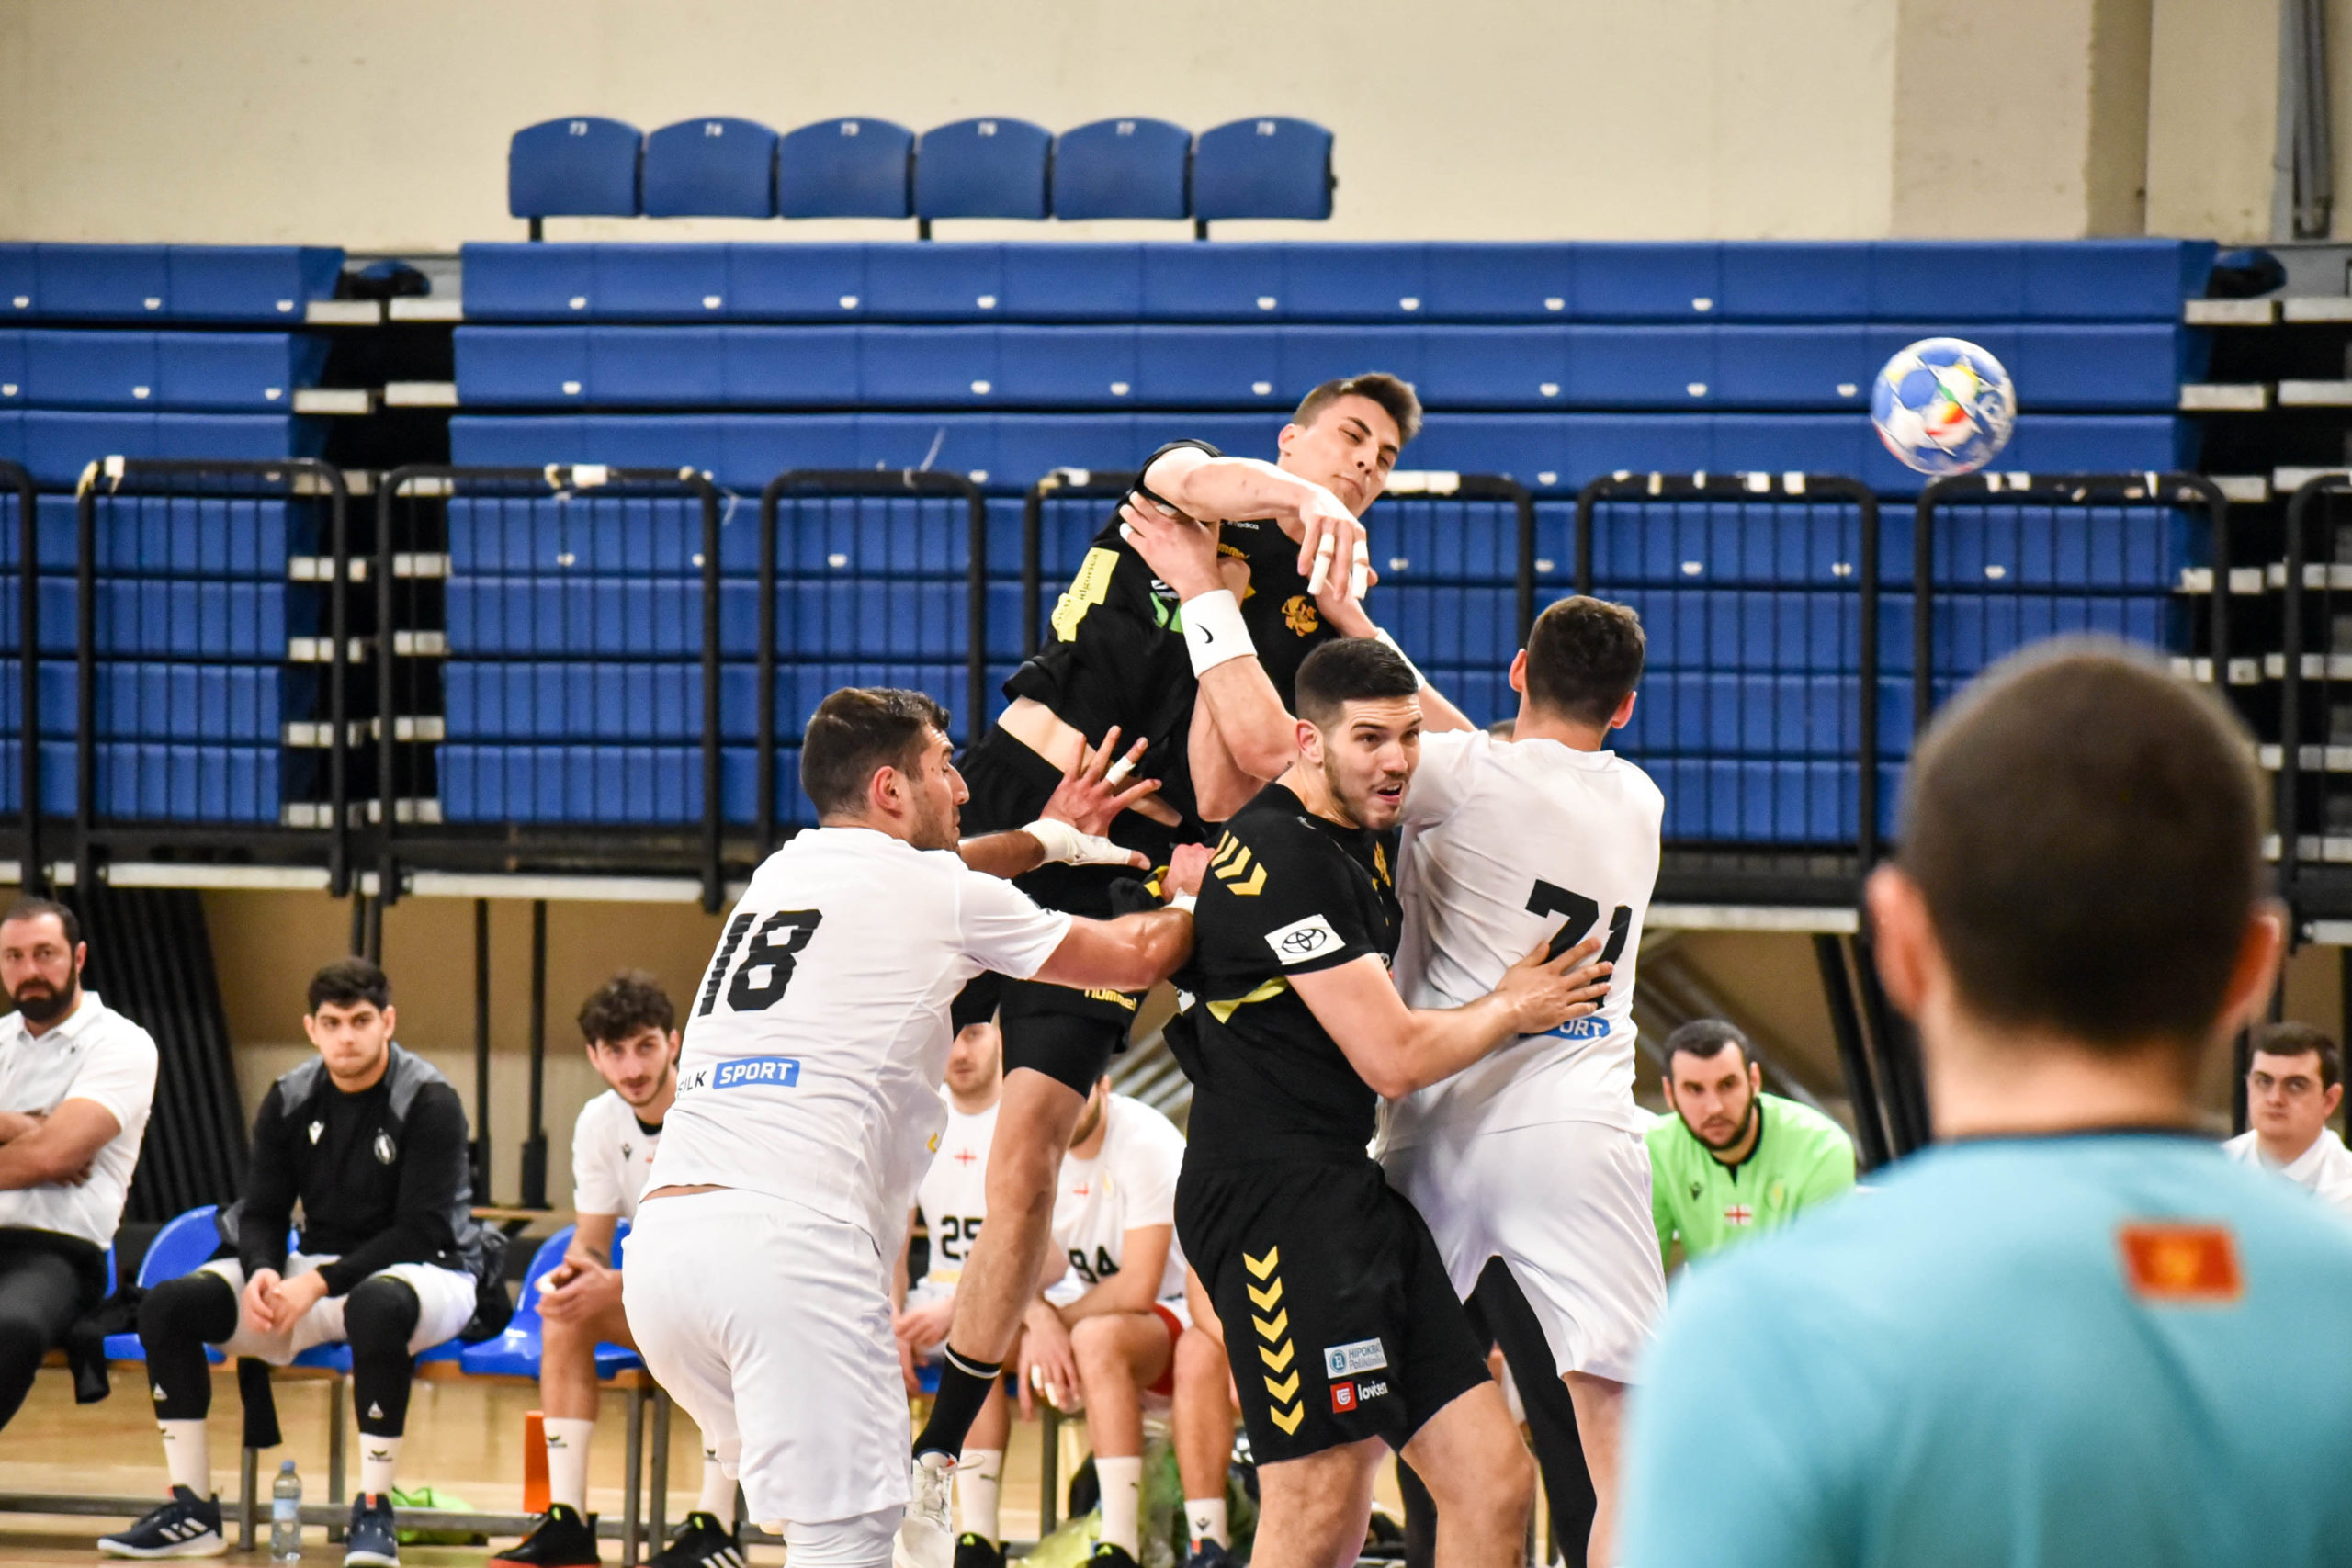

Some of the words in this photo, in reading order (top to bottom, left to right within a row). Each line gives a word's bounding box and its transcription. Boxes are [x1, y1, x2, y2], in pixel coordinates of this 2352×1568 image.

[697, 908, 823, 1017] 18
[1525, 879, 1632, 1010] 71
[1559, 1019, 1603, 1037] ORT
[719, 1062, 793, 1085] SPORT
